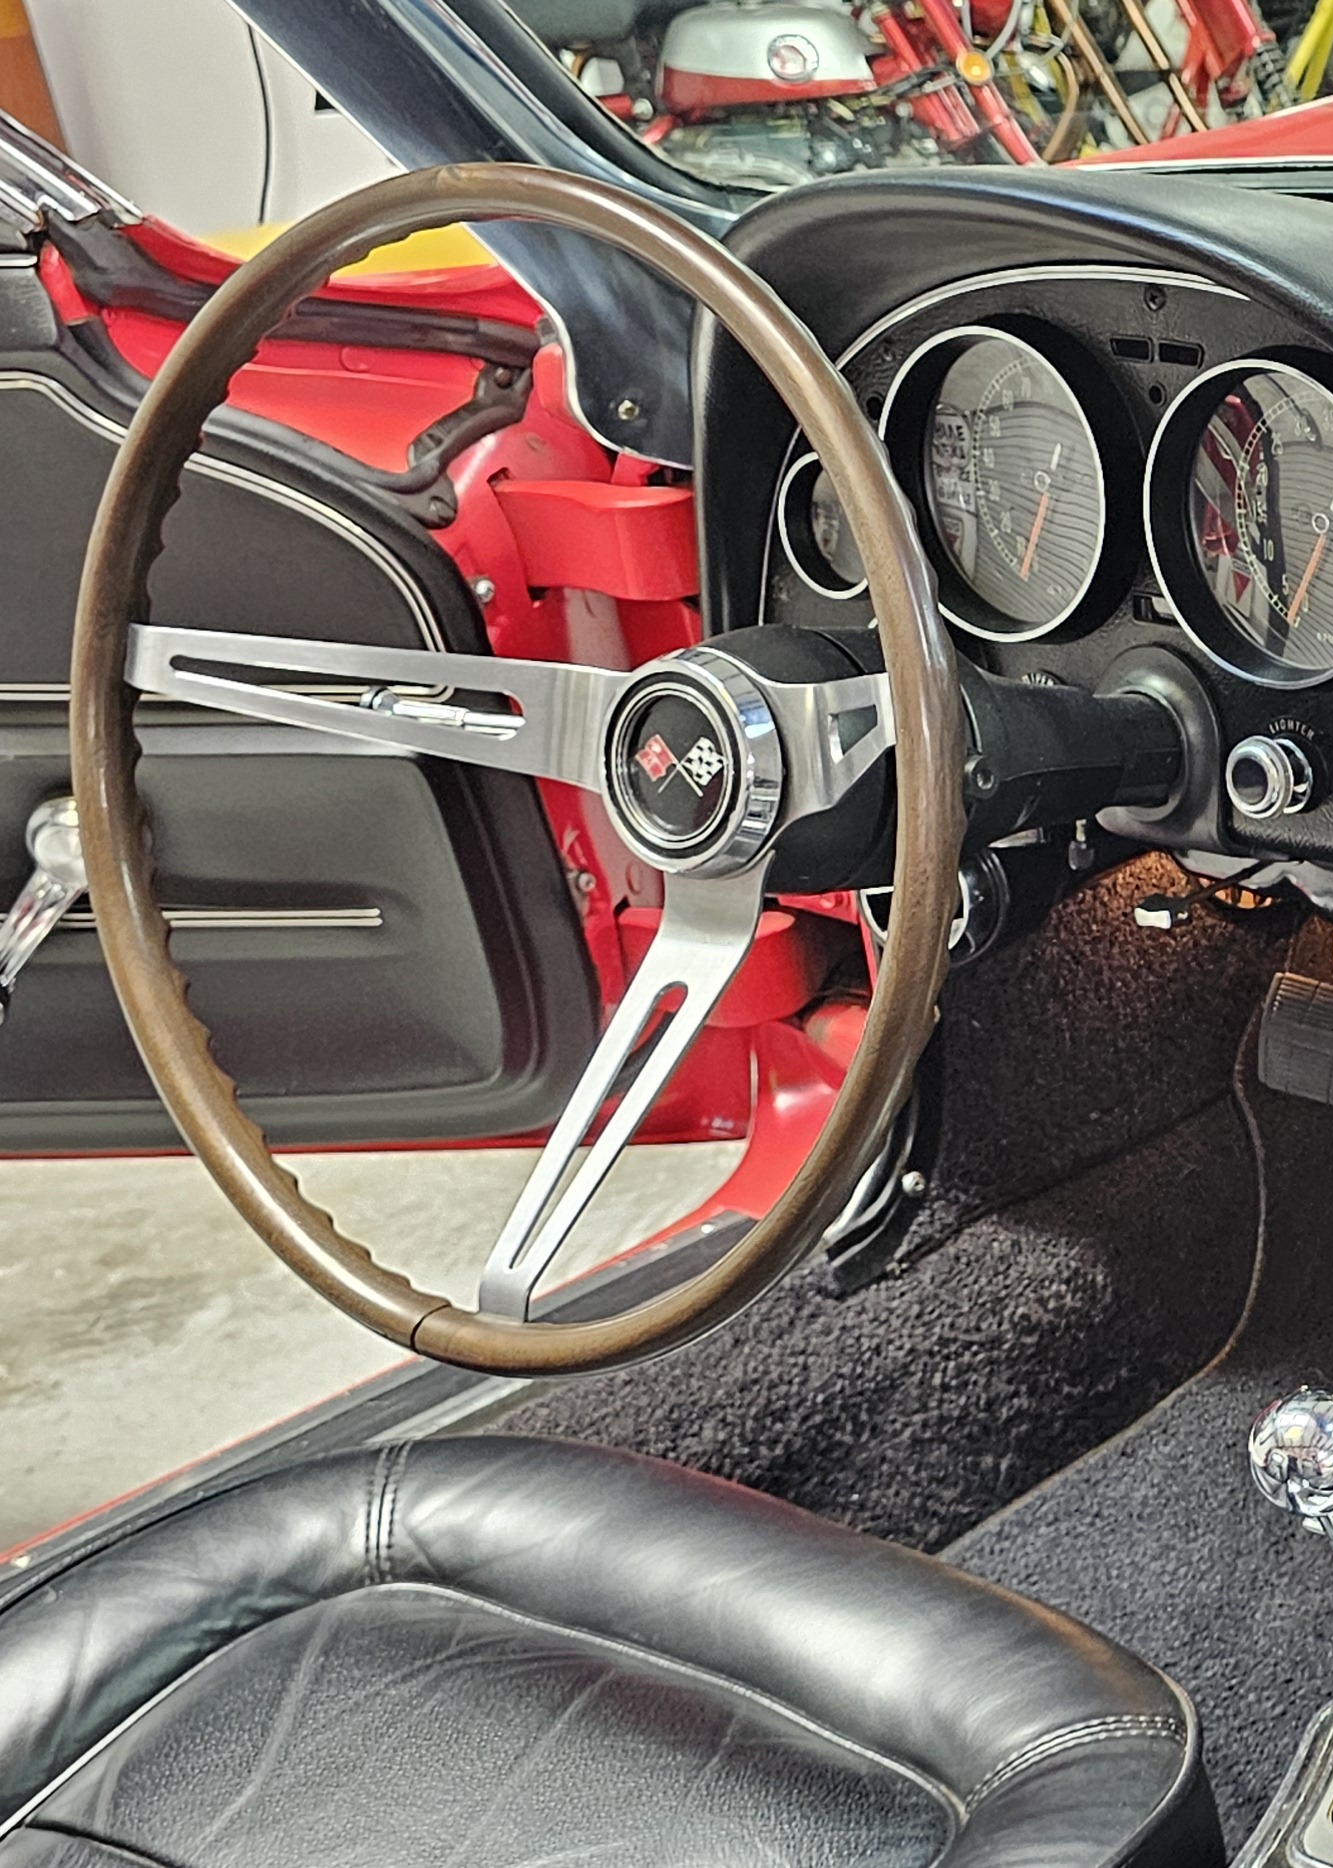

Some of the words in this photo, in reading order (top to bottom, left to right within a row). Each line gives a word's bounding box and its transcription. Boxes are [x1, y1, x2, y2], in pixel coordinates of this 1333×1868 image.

[1263, 538, 1275, 561] 10
[1282, 574, 1290, 595] 5
[1269, 719, 1315, 740] LIGHTER
